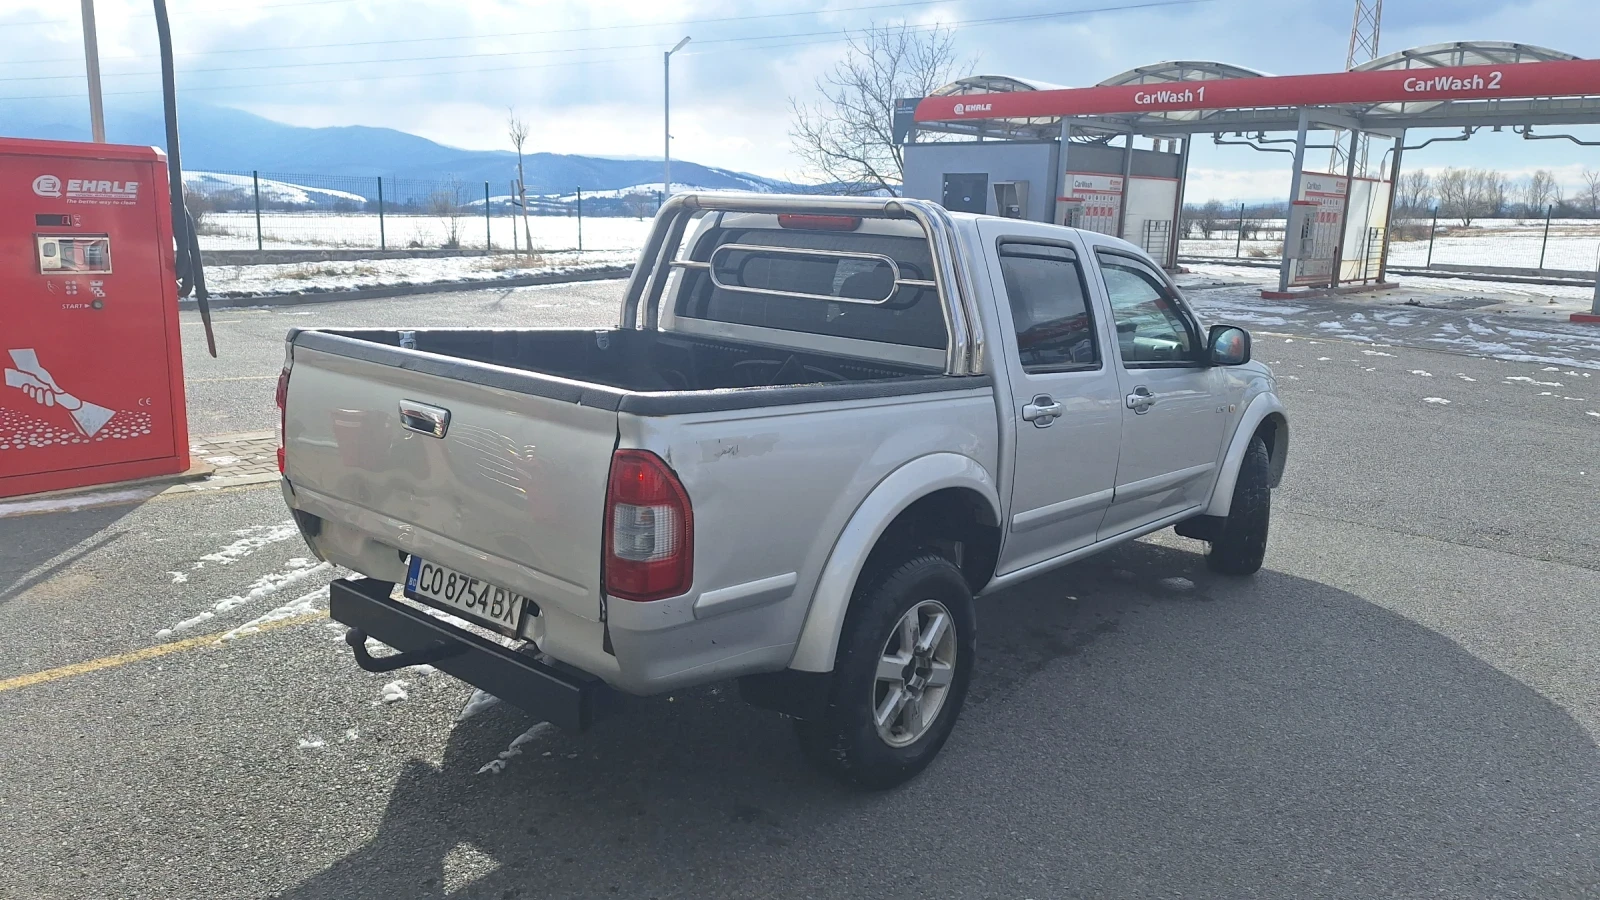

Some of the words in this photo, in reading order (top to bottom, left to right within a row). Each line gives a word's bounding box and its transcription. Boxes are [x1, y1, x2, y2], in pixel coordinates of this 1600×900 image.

[1403, 74, 1484, 92] CarWash
[1487, 71, 1503, 89] 2
[1134, 89, 1193, 105] CarWash
[1196, 86, 1205, 102] 1
[965, 103, 992, 112] EHRLE
[66, 179, 138, 193] EHRLE
[1074, 180, 1093, 189] CarWash
